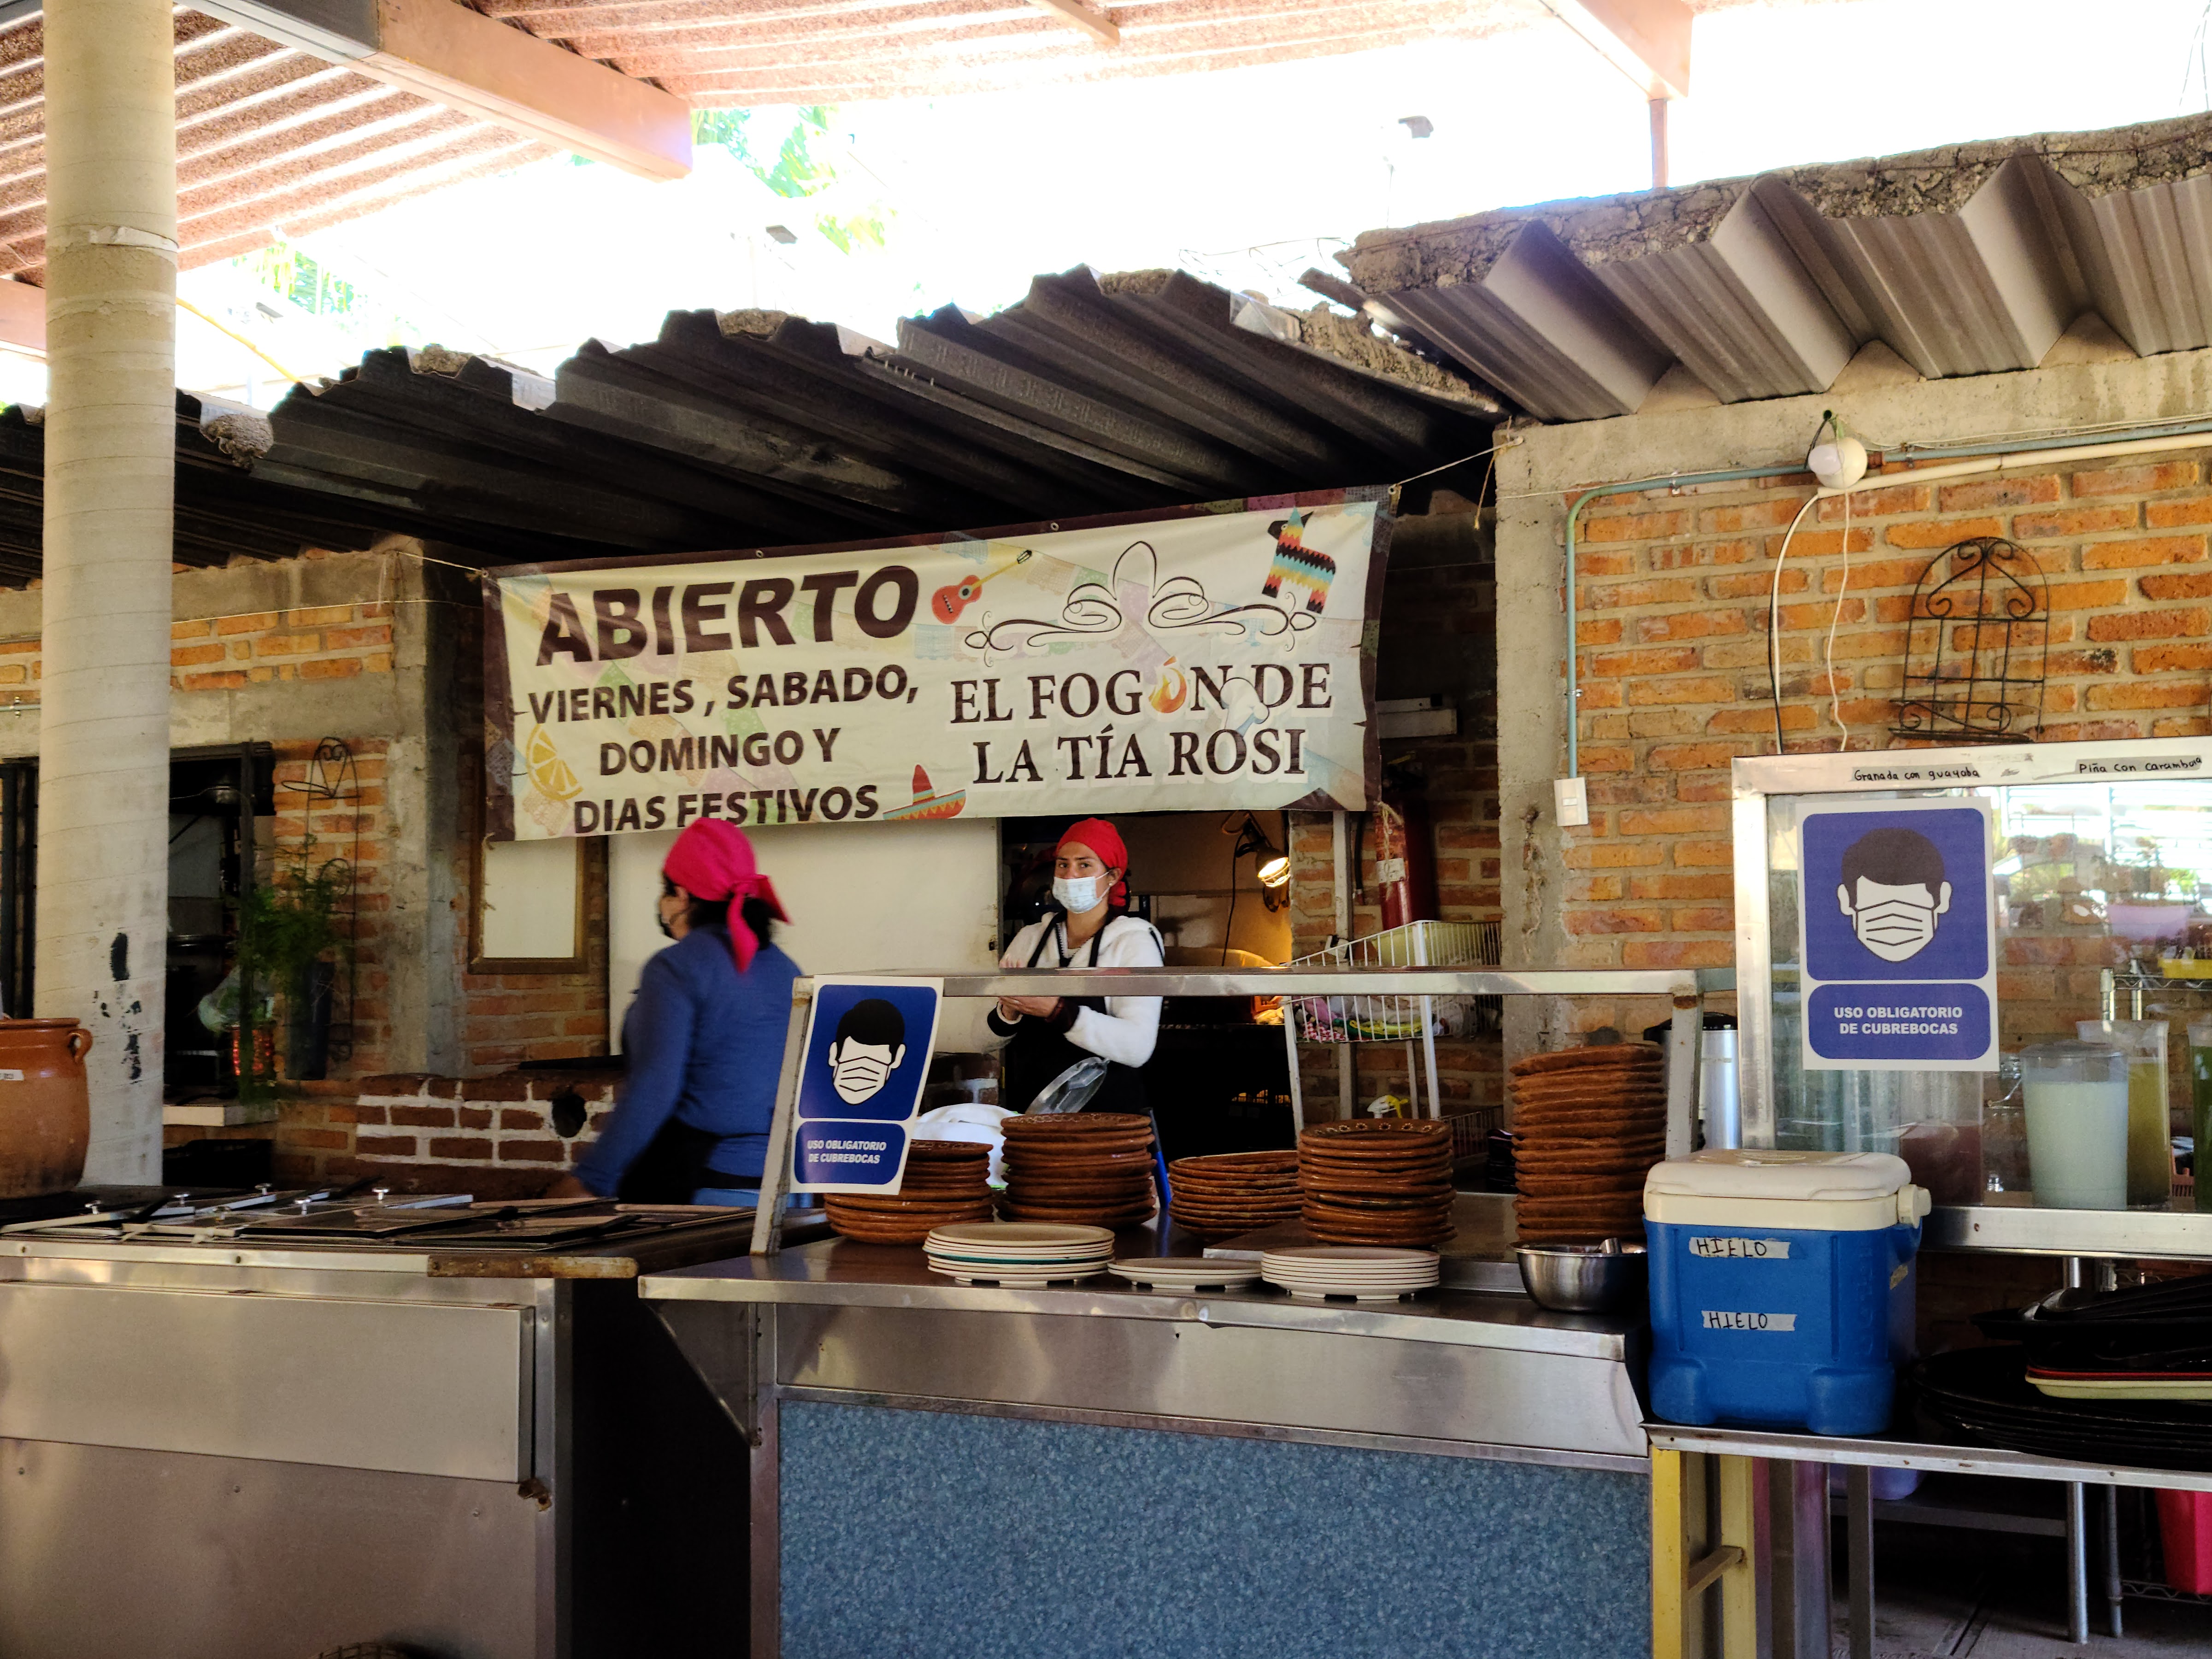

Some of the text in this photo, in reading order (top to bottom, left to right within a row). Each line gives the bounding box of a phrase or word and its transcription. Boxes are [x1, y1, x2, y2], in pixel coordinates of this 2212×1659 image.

[536, 565, 919, 666] ABIERTO
[727, 664, 918, 709] SABADO,
[950, 678, 1013, 724] EL
[1251, 663, 1333, 709] DE
[600, 728, 841, 776] DOMINGO Y
[973, 723, 1306, 784] LA TÍA ROSI
[1854, 769, 1899, 782] Granada
[1929, 767, 1980, 781] guayaba
[2079, 763, 2107, 774] Piña
[574, 785, 879, 833] DIAS FESTIVOS
[1834, 1006, 1963, 1018] USO OBLIGATORIO
[1840, 1023, 1958, 1034] DE CUBREBOCAS
[807, 1140, 887, 1151] USO OBLIGATORIO
[808, 1153, 881, 1164] DE CUBREBOCAS
[1697, 1238, 1767, 1257] HIELO
[1709, 1312, 1768, 1330] HIELO
